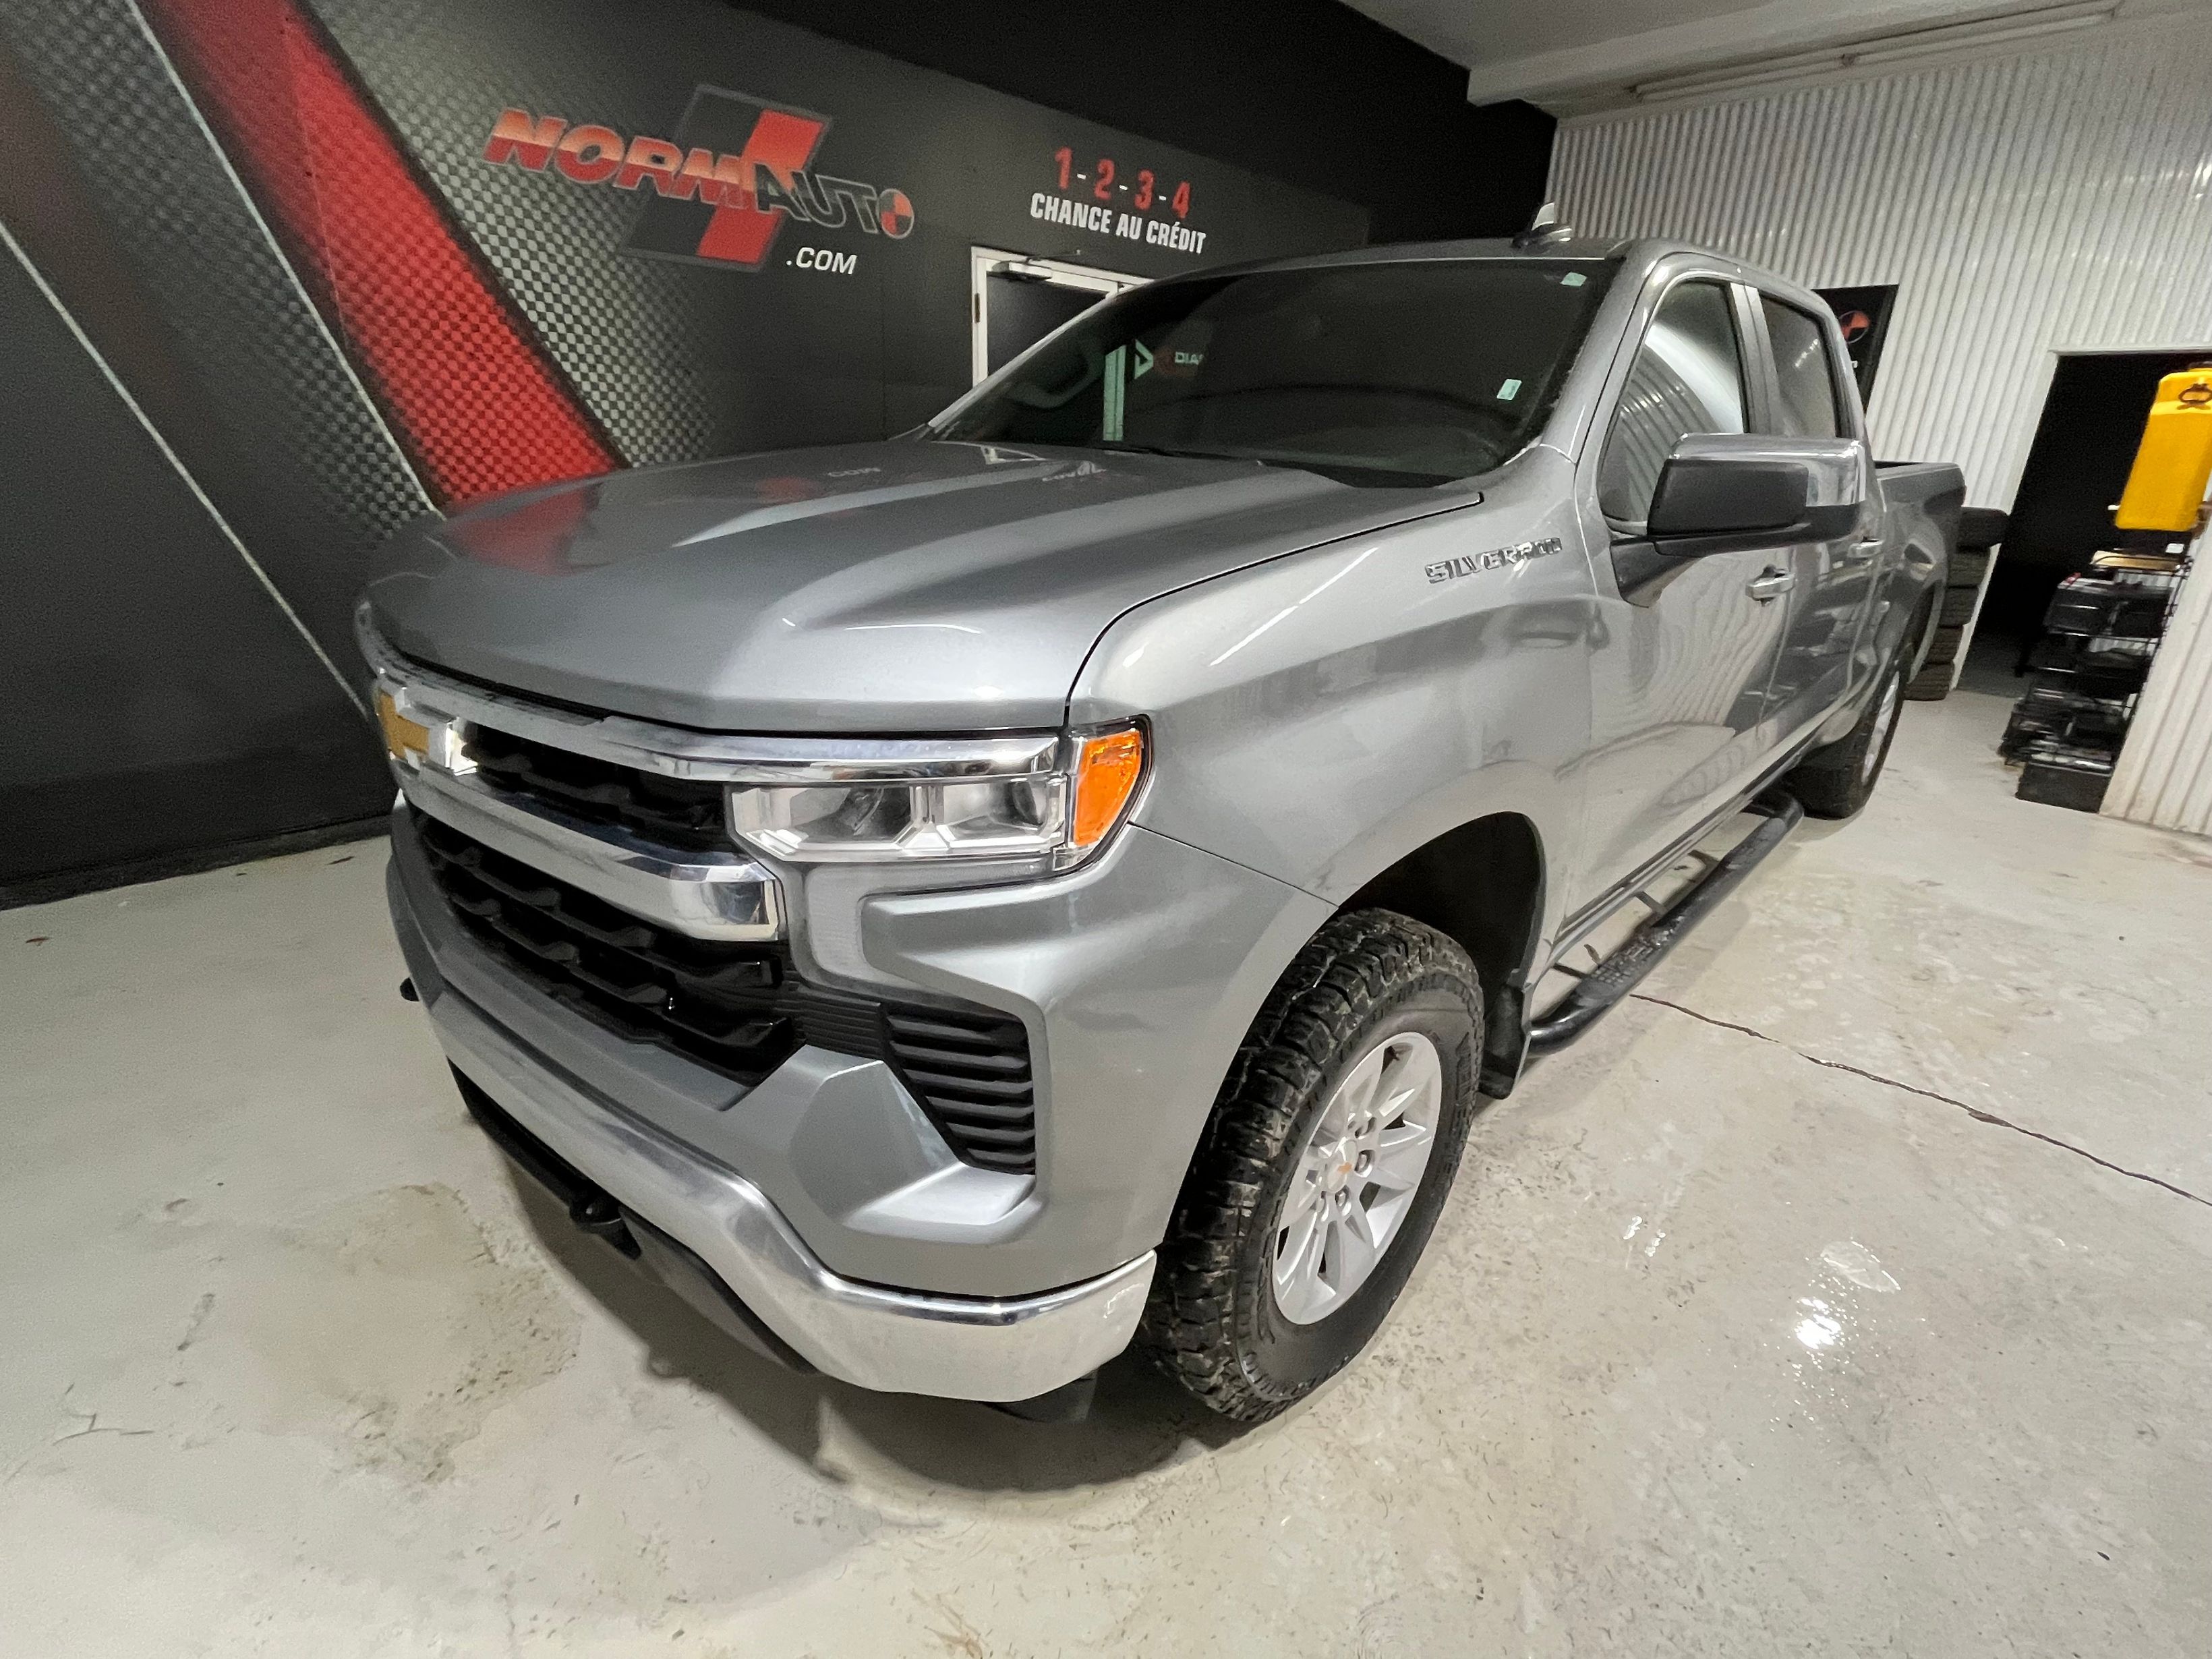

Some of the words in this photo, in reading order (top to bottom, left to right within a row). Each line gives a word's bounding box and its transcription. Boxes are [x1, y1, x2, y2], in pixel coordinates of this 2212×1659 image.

[1030, 192, 1112, 233] CHANCE
[1115, 213, 1142, 239] AU
[1146, 221, 1206, 254] CRÉDIT
